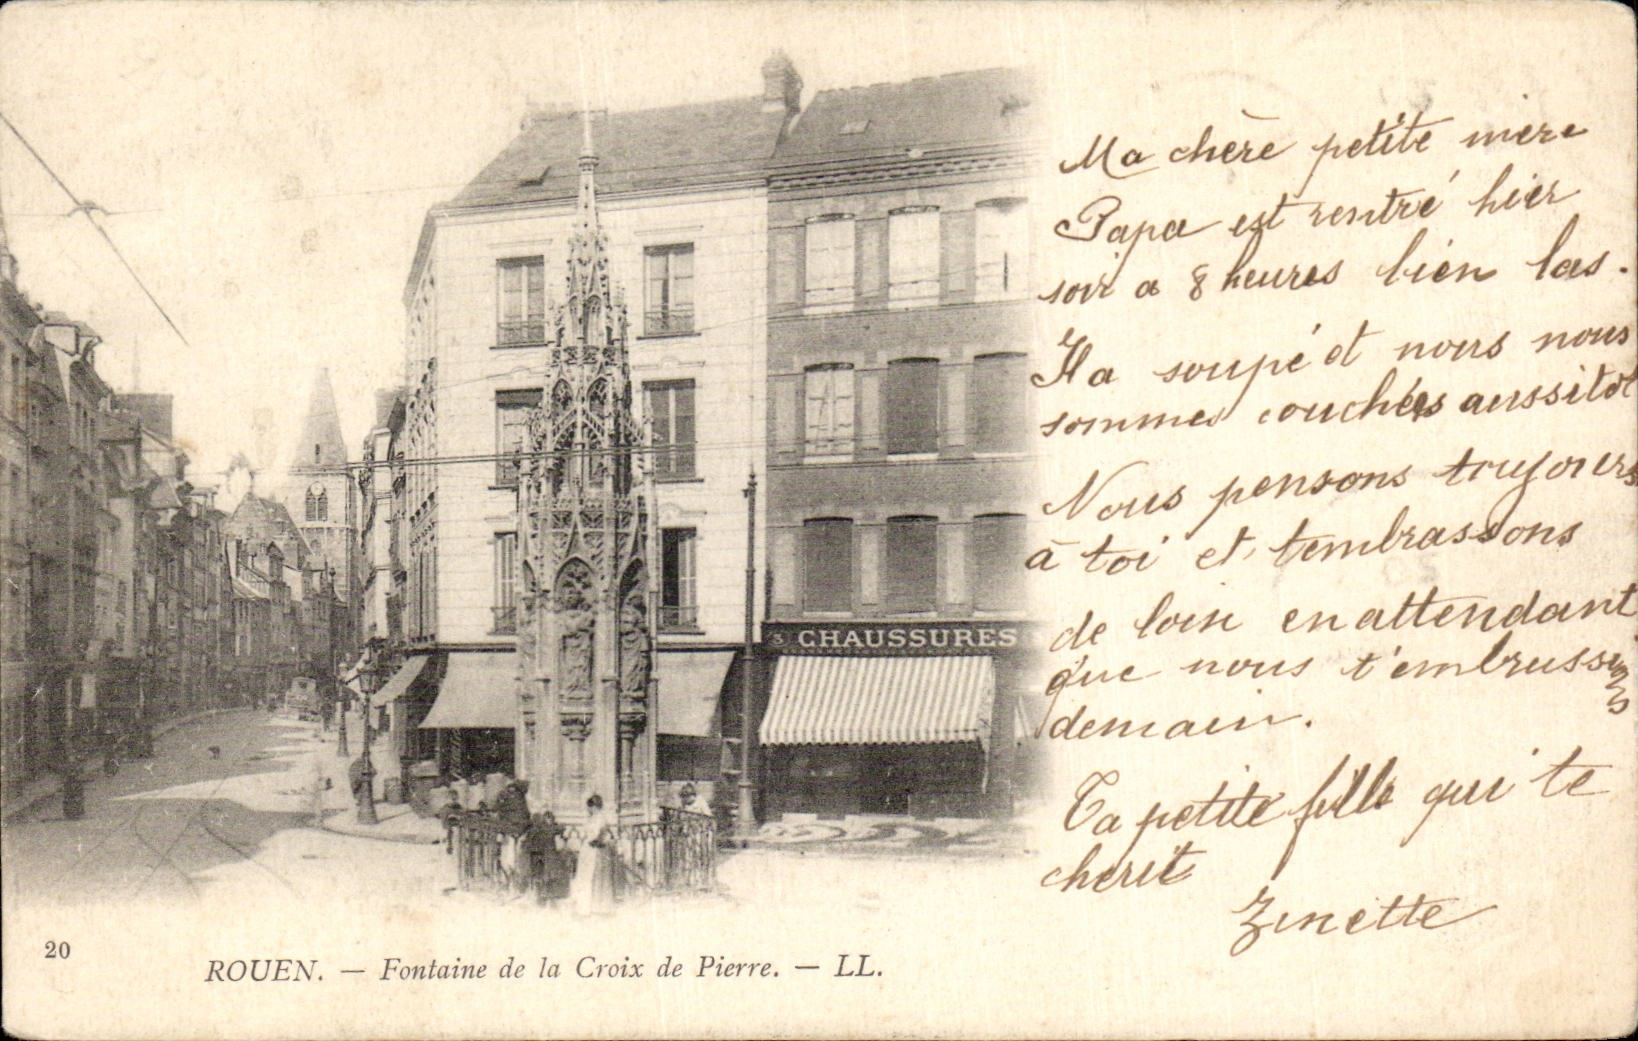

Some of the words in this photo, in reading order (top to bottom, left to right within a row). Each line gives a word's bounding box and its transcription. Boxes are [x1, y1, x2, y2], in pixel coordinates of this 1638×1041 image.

[1059, 134, 1160, 179] Ma
[1168, 109, 1300, 163] chère
[1298, 111, 1455, 199] petite
[1054, 195, 1223, 284] Papa
[1228, 192, 1310, 237] est
[1308, 169, 1462, 227] rentré
[1468, 163, 1581, 216] hier
[1038, 252, 1118, 305] soir
[1189, 263, 1210, 301] 8
[1221, 229, 1344, 292] heures
[1377, 228, 1498, 286] bien
[1324, 319, 1386, 368] et
[1394, 328, 1506, 364] nous
[1531, 320, 1630, 352] nous
[1039, 403, 1224, 438] sommes
[1043, 460, 1184, 522] Nous
[1185, 463, 1411, 541] pensons
[1080, 533, 1170, 576] toi
[797, 628, 1019, 648] CHAUSSURES
[1048, 610, 1108, 653] de
[1134, 583, 1244, 640] loin
[1180, 656, 1316, 679] nous
[1063, 769, 1123, 837] Ta
[1114, 764, 1286, 866] petite
[1271, 753, 1399, 881] fille
[1400, 749, 1538, 849] qui
[1529, 745, 1613, 797] te
